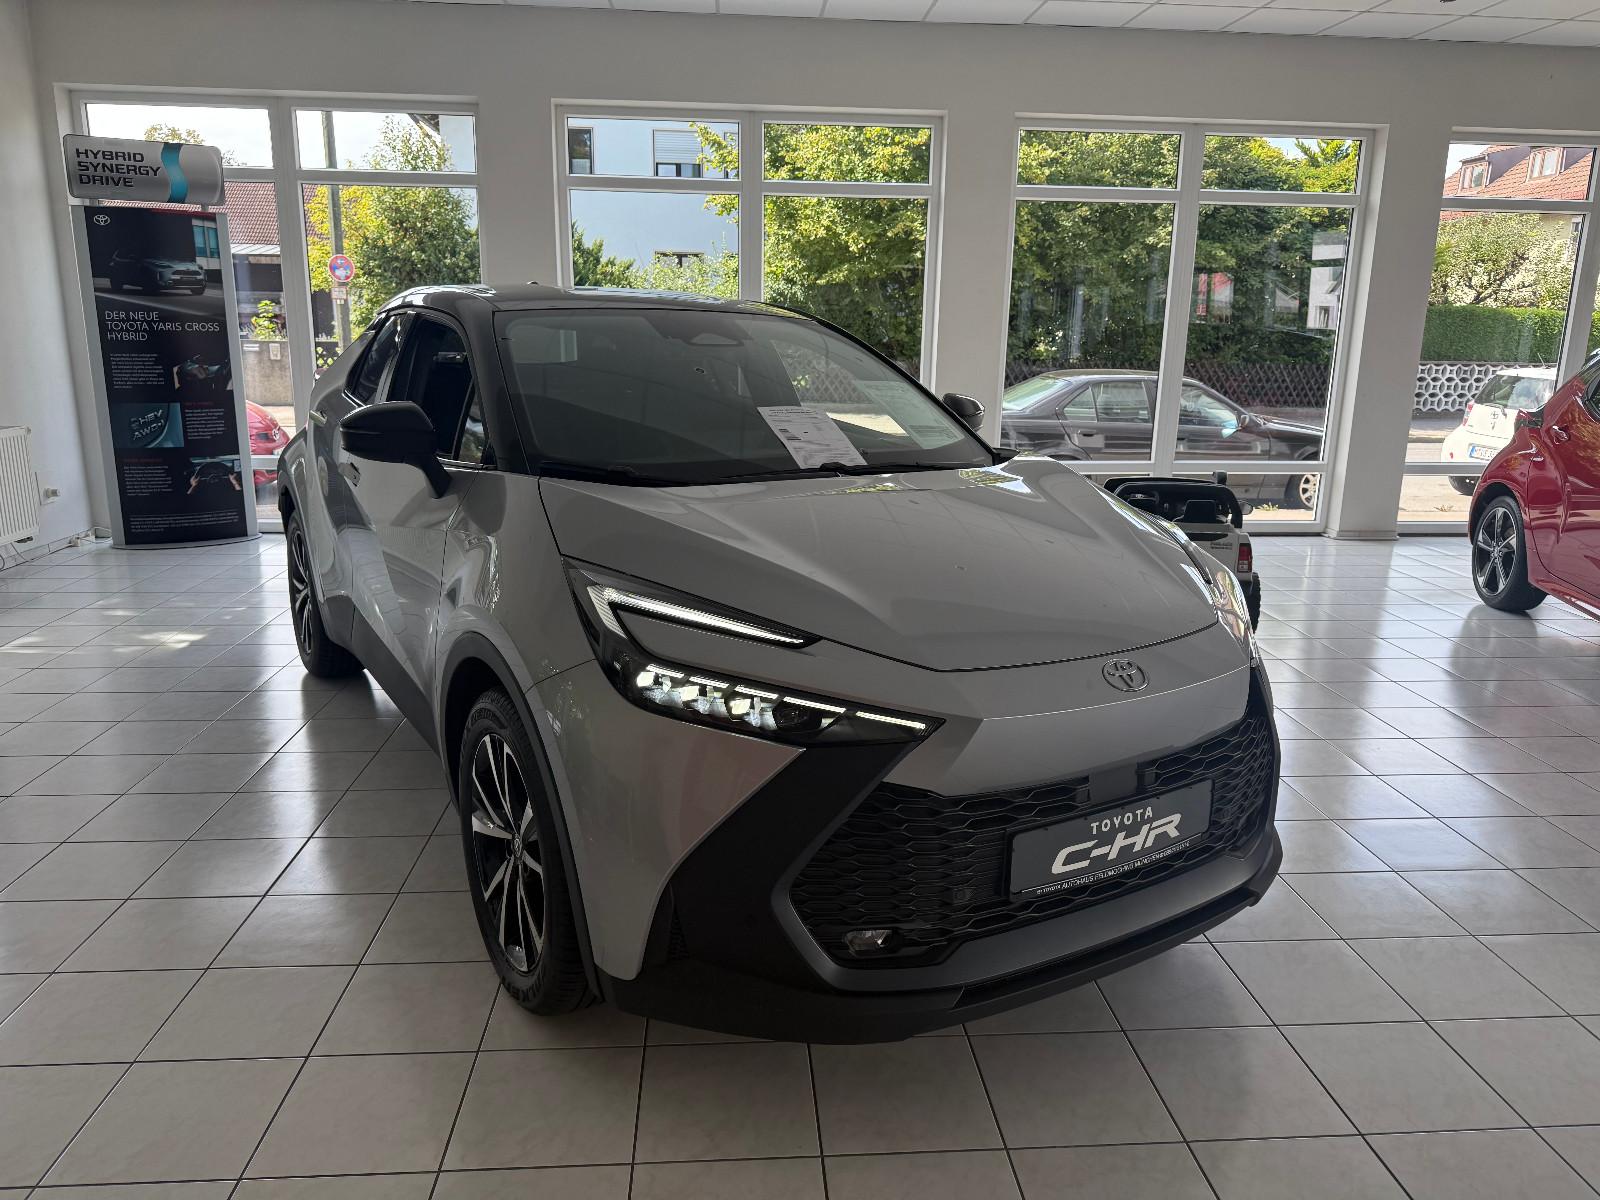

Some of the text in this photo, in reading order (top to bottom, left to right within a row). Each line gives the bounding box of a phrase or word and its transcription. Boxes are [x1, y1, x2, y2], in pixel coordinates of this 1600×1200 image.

[75, 148, 145, 163] HYBRID
[77, 161, 161, 177] SYNERGY
[79, 174, 135, 188] DRIVE
[105, 310, 160, 321] DER NEUE
[106, 321, 220, 332] TOYOTA YARIS CROSS
[107, 331, 148, 342] HYBRID
[1090, 806, 1153, 835] TOYOTA
[1051, 813, 1182, 875] C-HR
[1061, 875, 1094, 889] AUTOHAUS
